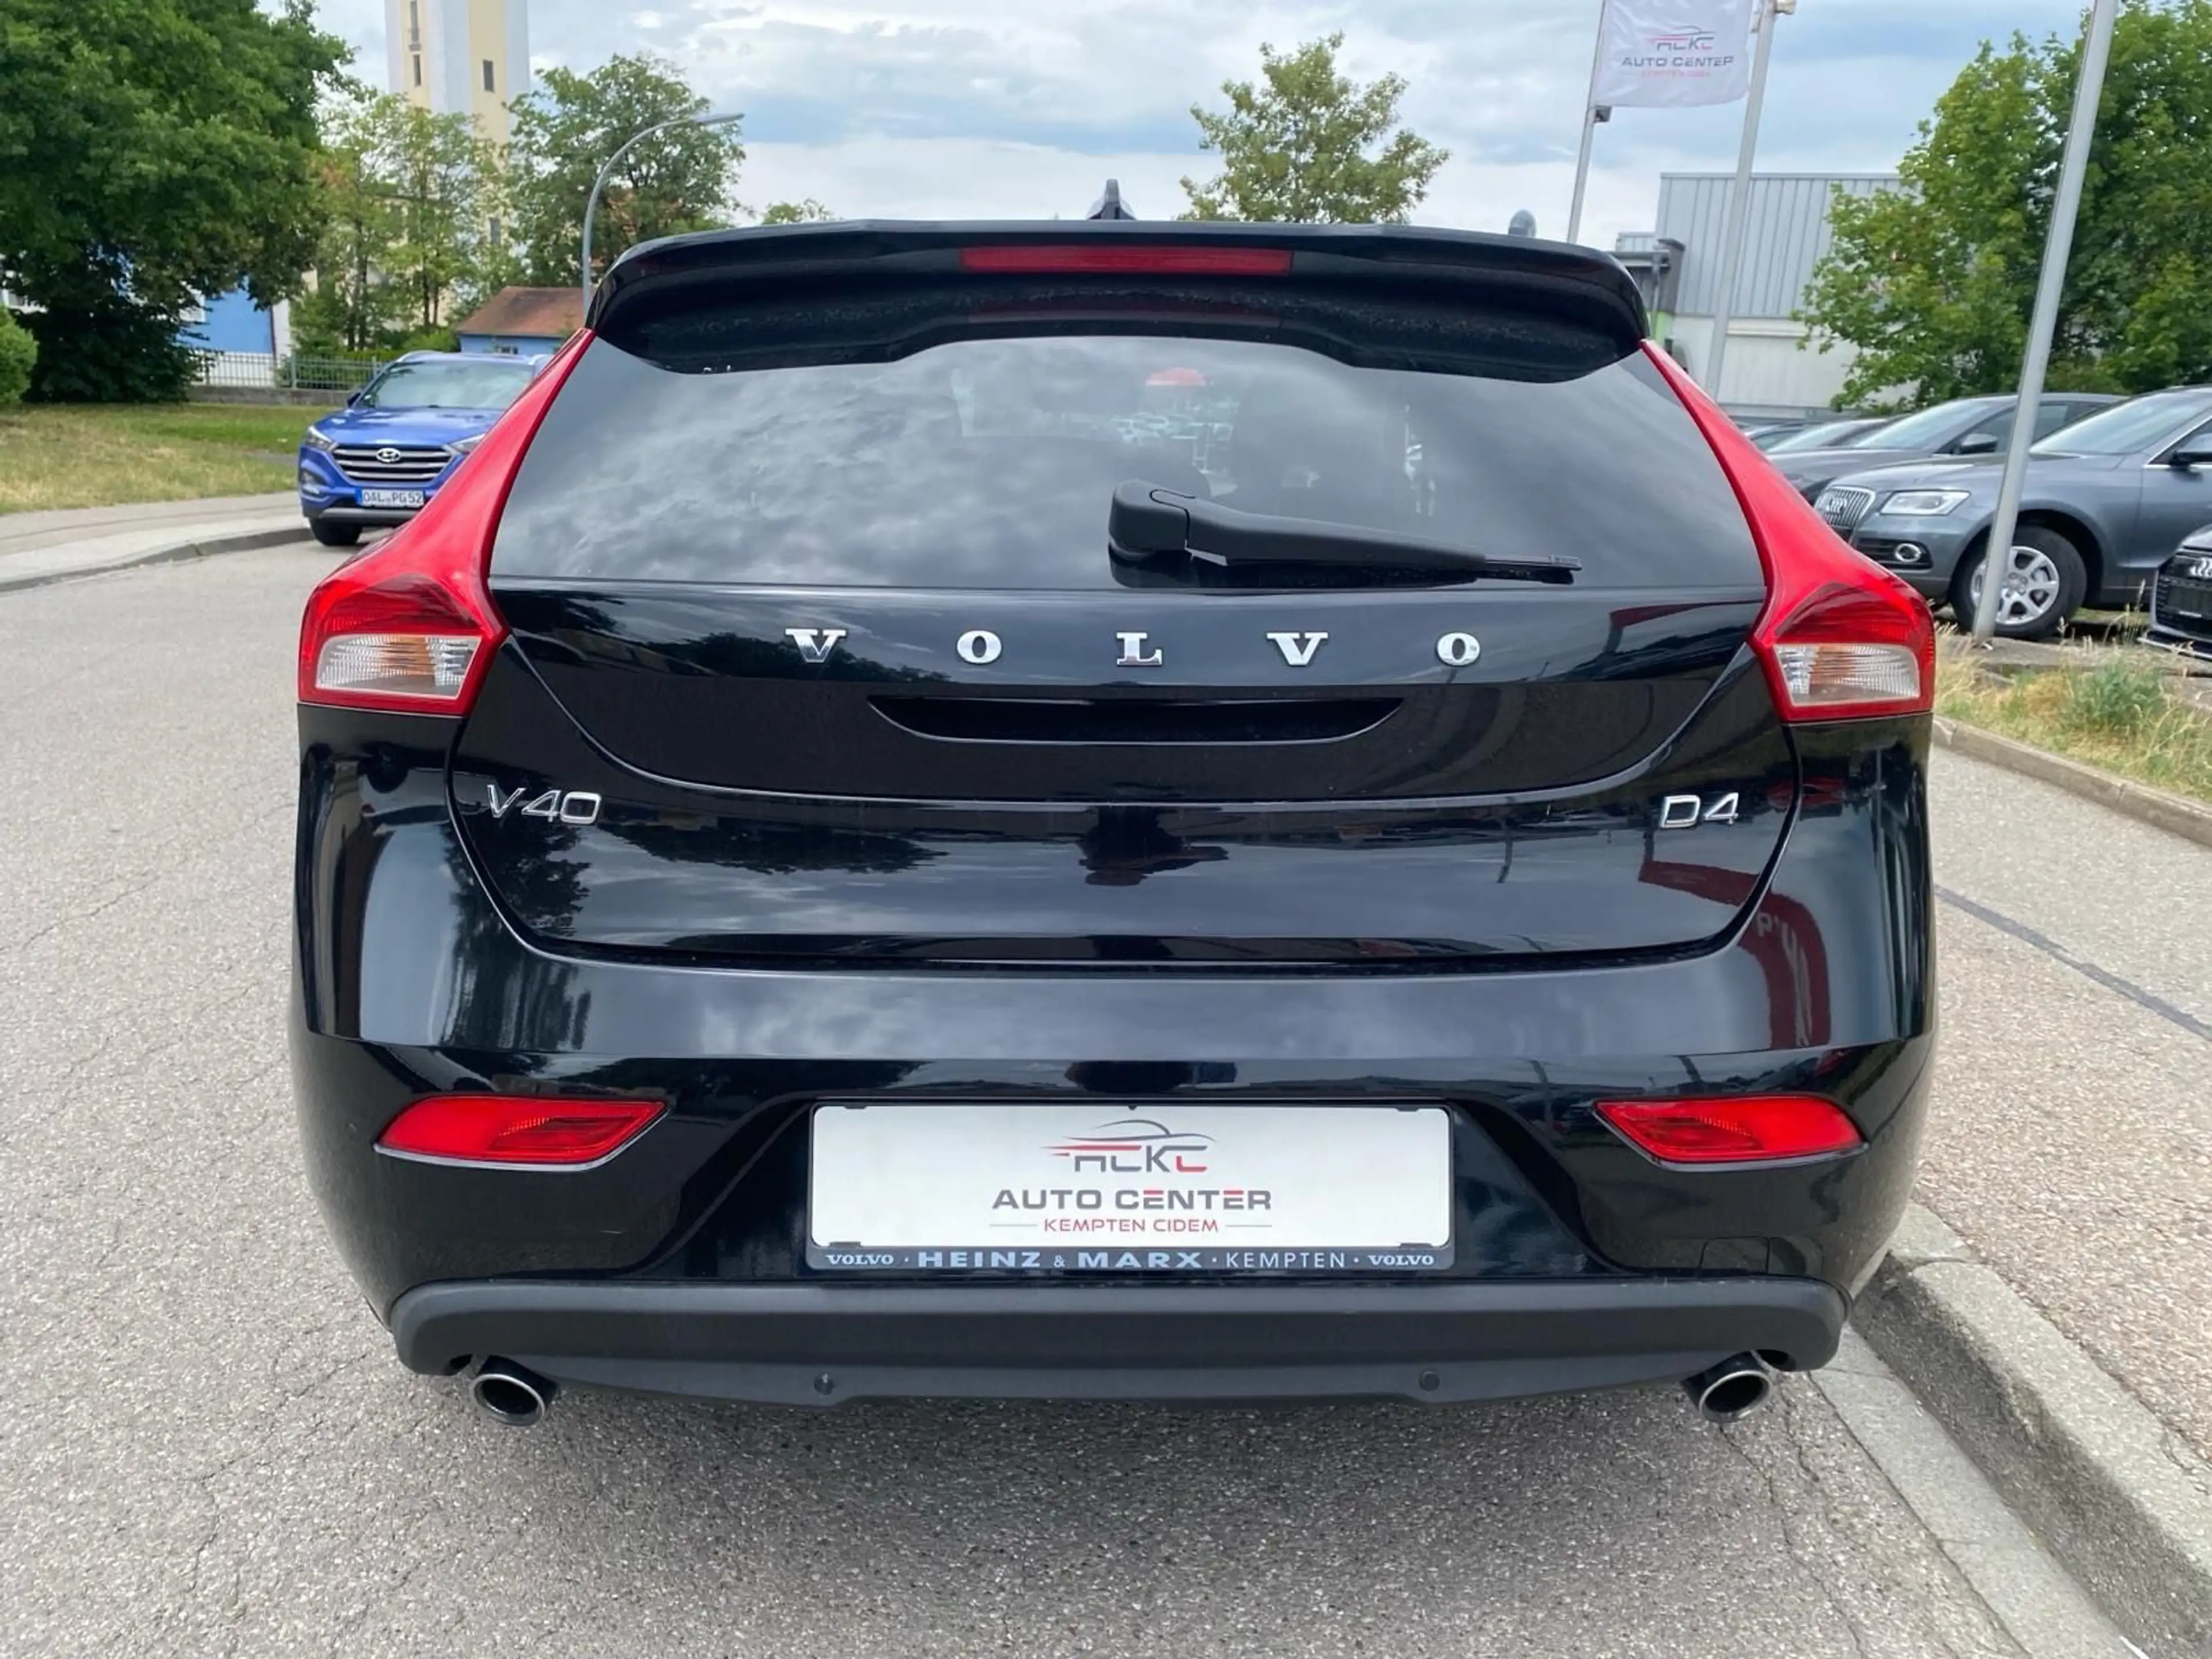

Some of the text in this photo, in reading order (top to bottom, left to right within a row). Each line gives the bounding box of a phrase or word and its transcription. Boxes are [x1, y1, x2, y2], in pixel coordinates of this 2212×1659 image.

[1621, 56, 1668, 67] AUTO
[786, 628, 1482, 668] VOLVO
[487, 784, 602, 824] V40
[1660, 792, 1739, 828] D4
[991, 1188, 1272, 1210] AUTO CENTER
[1044, 1218, 1219, 1233] KEMPTEN CIDEM
[825, 1251, 1435, 1268] VOLVO HEINZ & MARX KEMPTEN VOLVO
